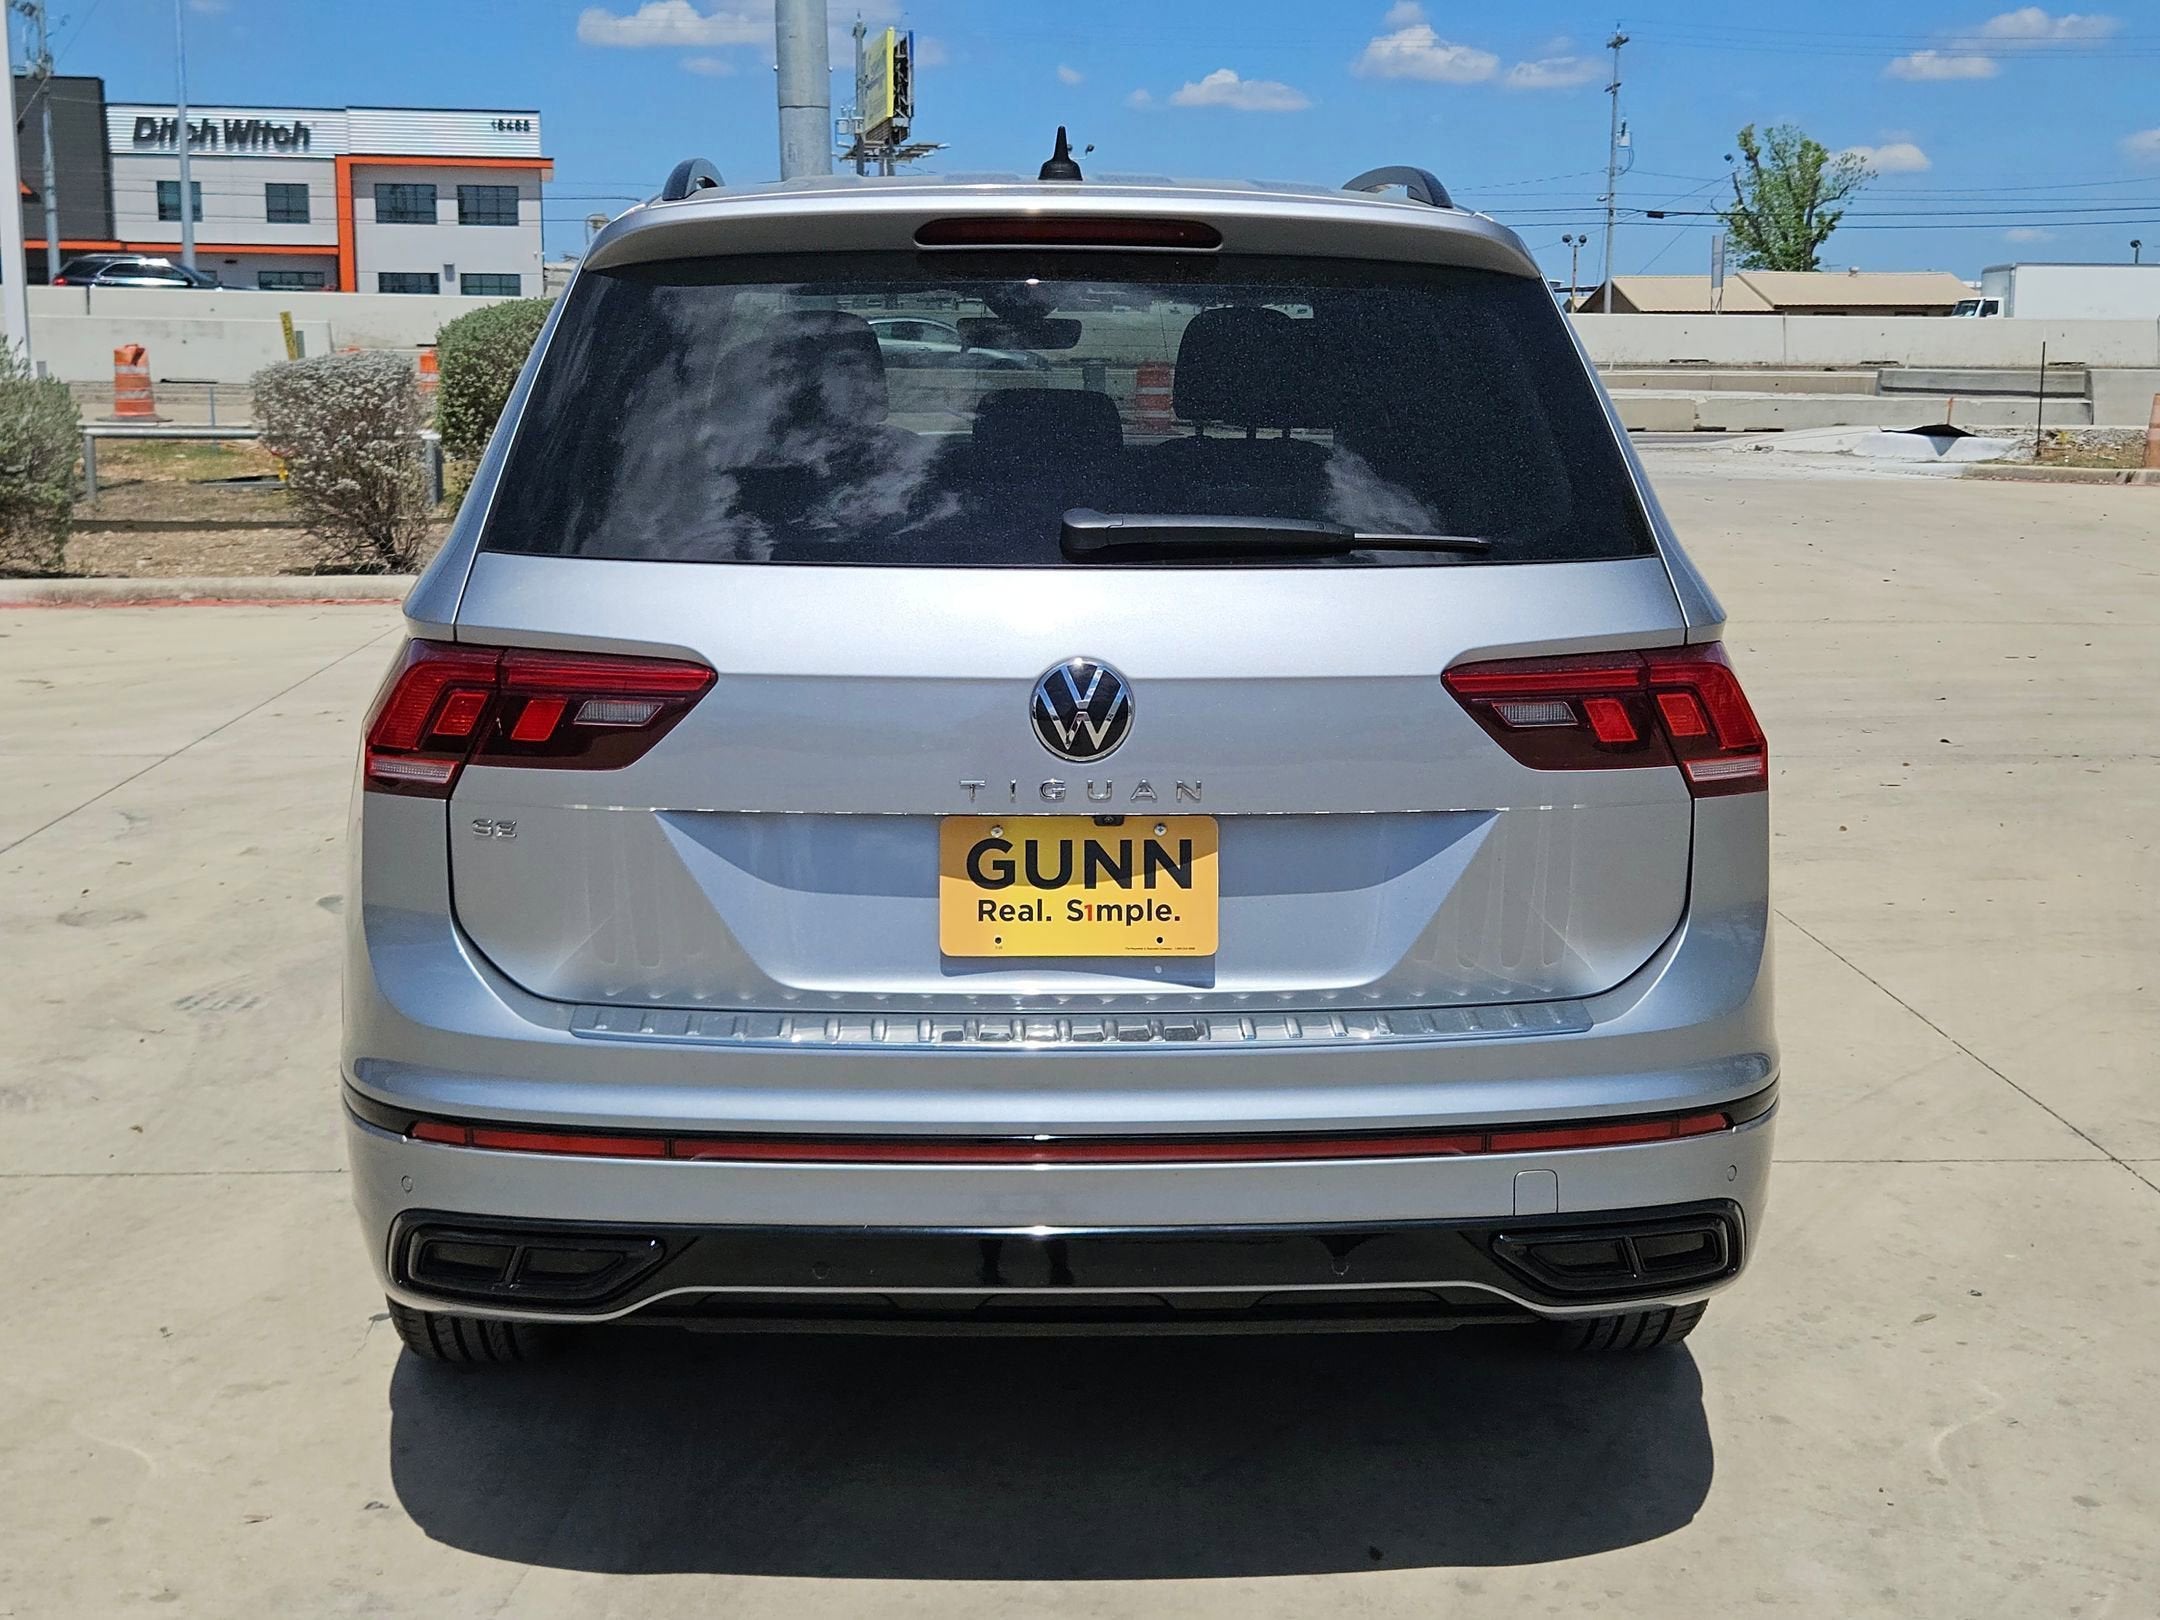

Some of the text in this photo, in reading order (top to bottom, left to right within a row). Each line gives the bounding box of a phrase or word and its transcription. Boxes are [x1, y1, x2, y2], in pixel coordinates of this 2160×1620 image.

[223, 118, 312, 147] Witch
[1034, 661, 1131, 753] VW
[959, 778, 1203, 802] TIGUAN
[471, 818, 518, 839] SE
[965, 837, 1193, 891] GUNN
[977, 898, 1182, 927] Real. S1mple.
